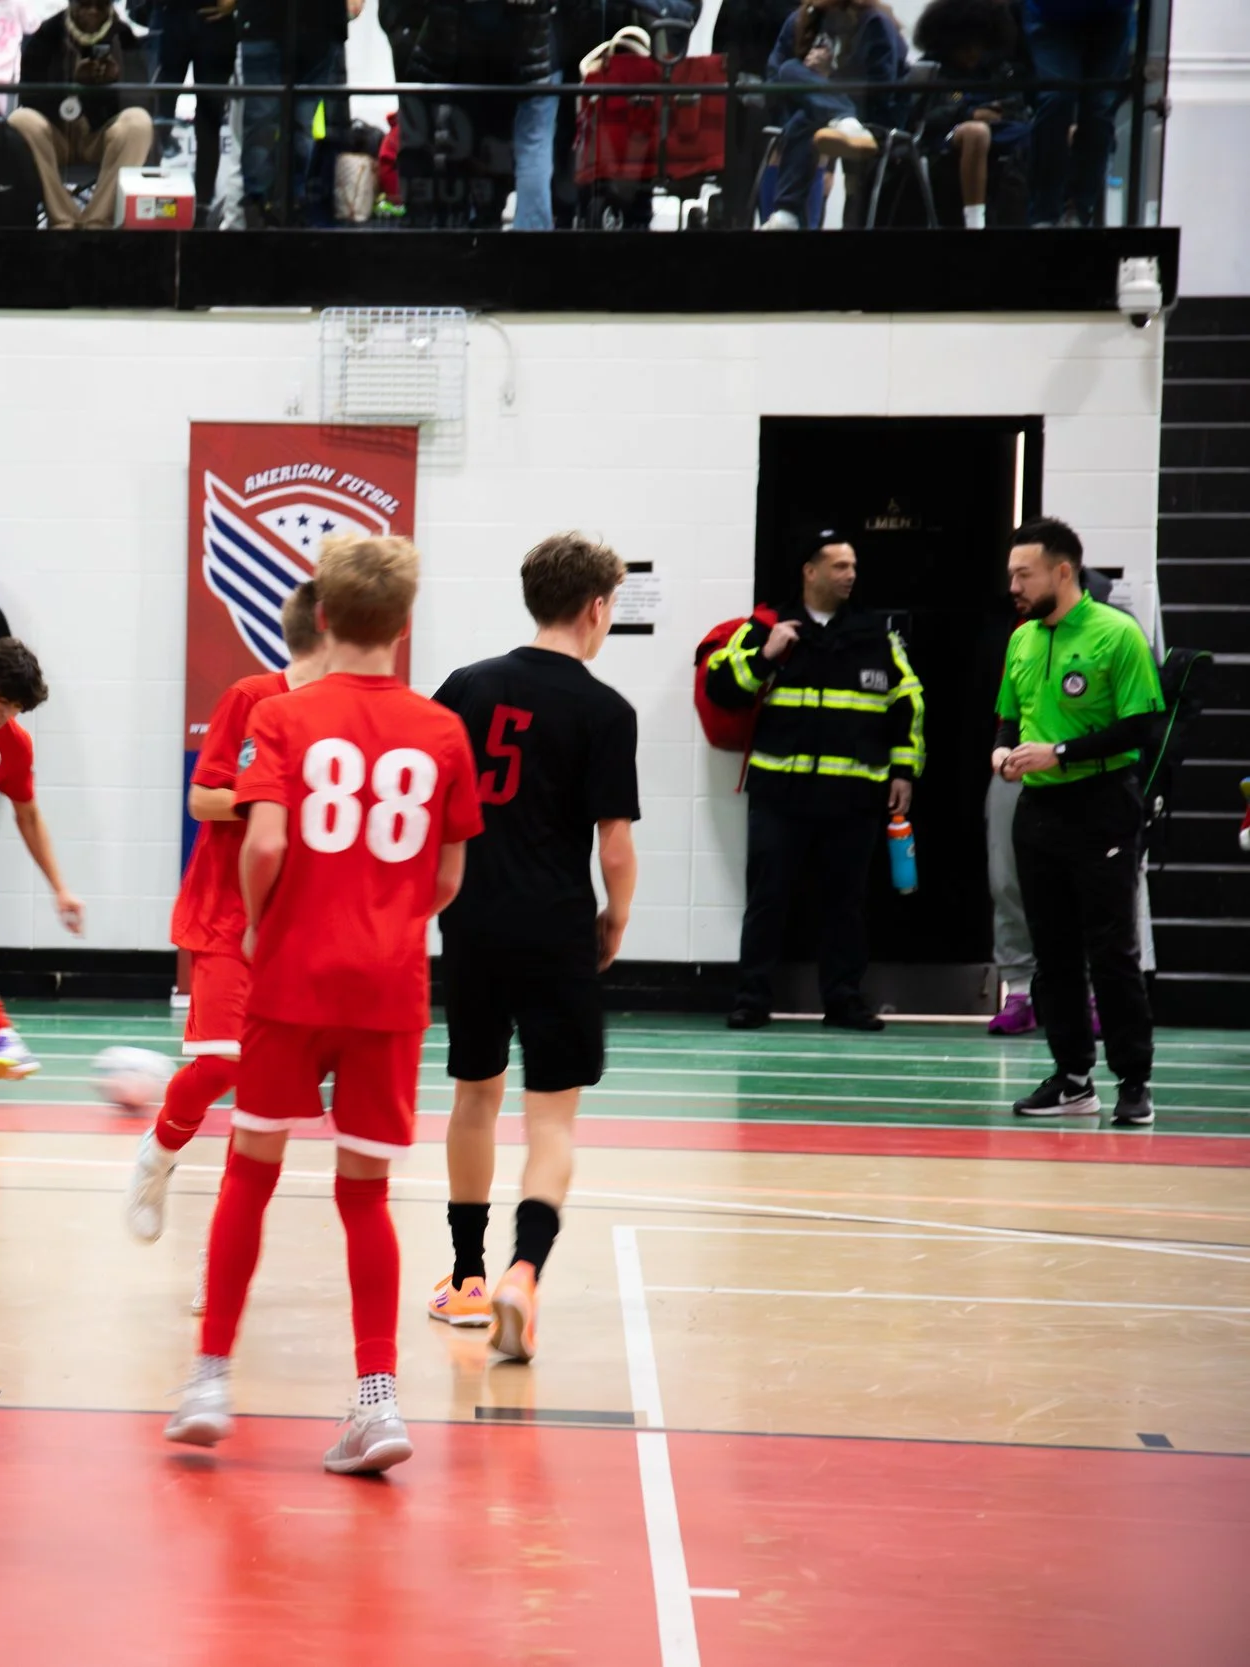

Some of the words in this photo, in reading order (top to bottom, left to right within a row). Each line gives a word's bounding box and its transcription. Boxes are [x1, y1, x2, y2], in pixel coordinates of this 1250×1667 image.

[244, 462, 336, 494] AMERICAN
[335, 473, 401, 516] FUTSAL
[301, 736, 439, 864] 88
[479, 703, 534, 806] 5
